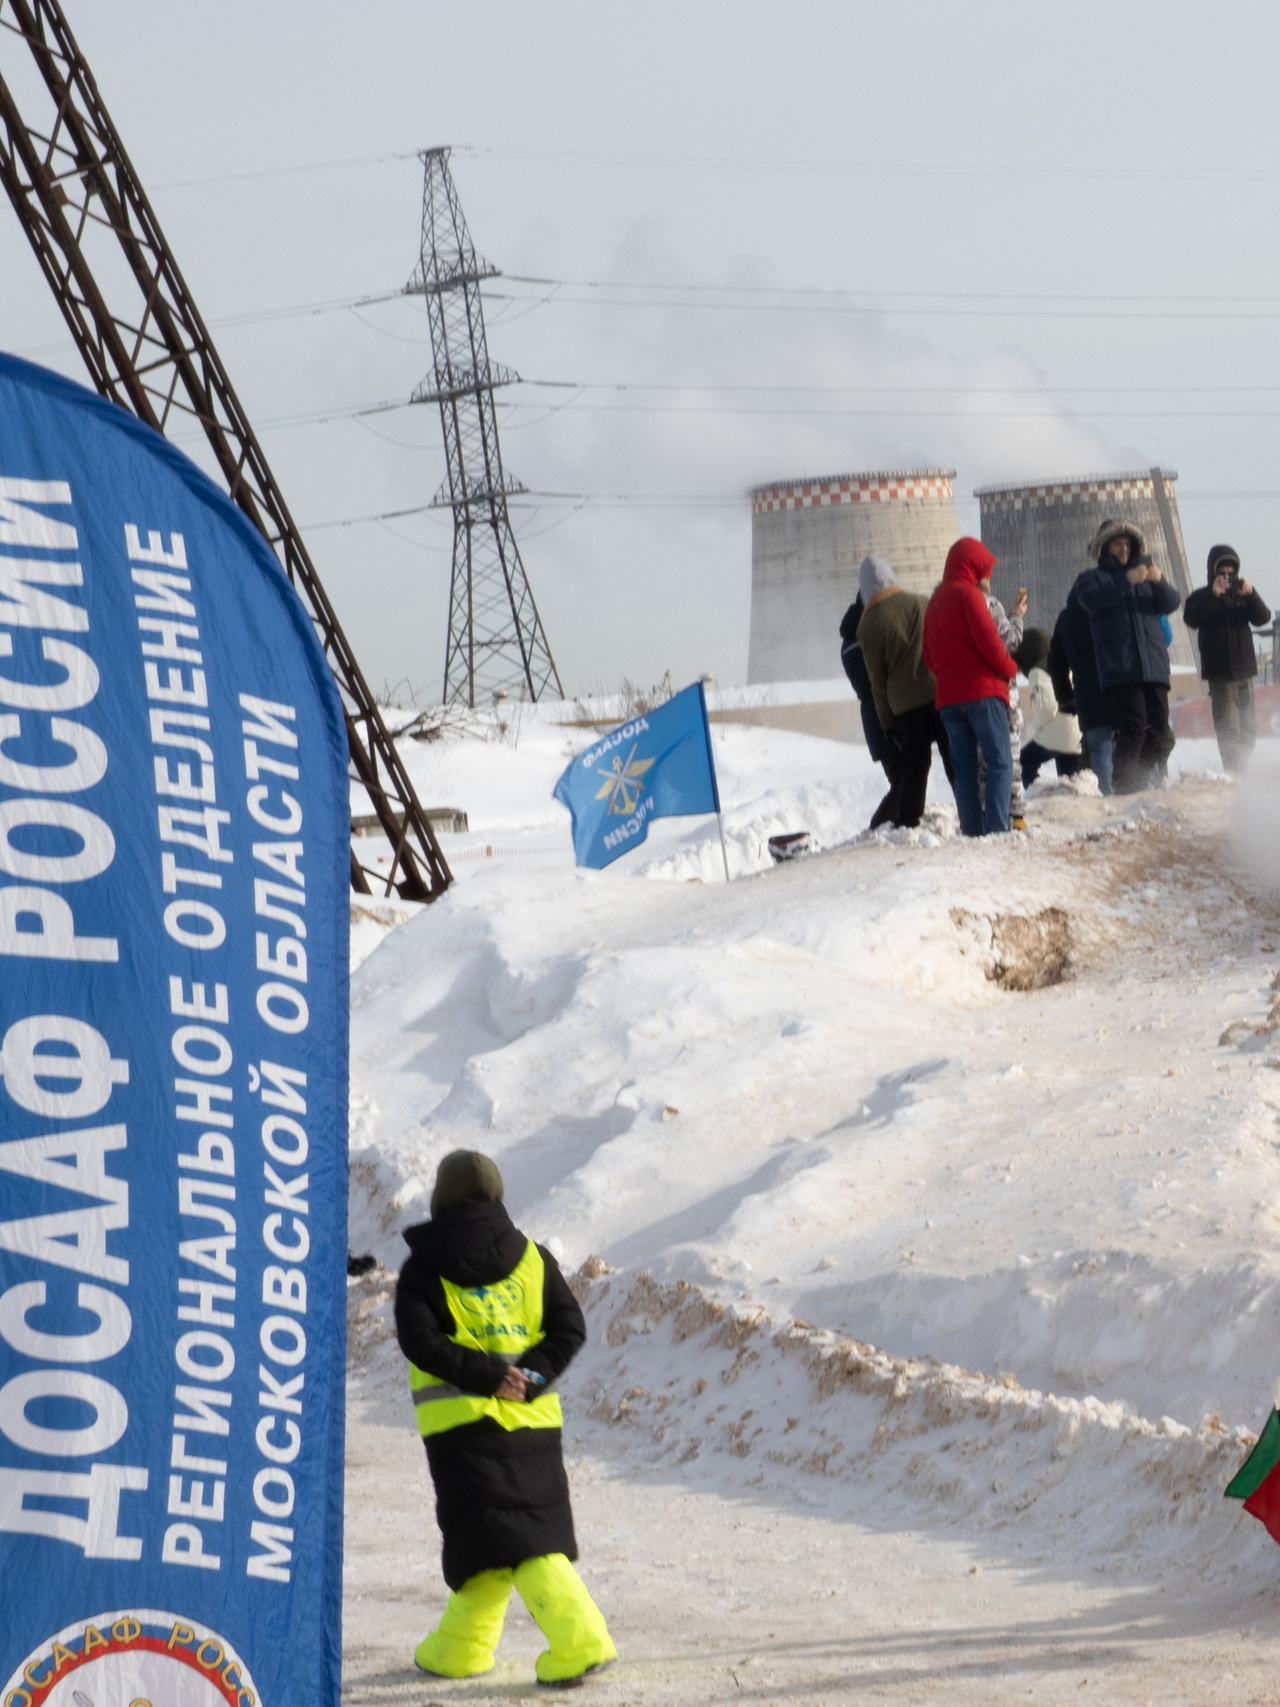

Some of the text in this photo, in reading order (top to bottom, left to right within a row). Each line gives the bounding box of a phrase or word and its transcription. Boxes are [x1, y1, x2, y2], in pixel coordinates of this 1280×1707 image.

[0, 476, 149, 1561] ДОСААФ РОССИИ
[125, 522, 237, 1570] РЕГИОНАЛЬНОЕ ОТДЕЛЕНИЕ
[239, 693, 310, 1583] МОСКОВСКОЙ ОБЛАСТИ
